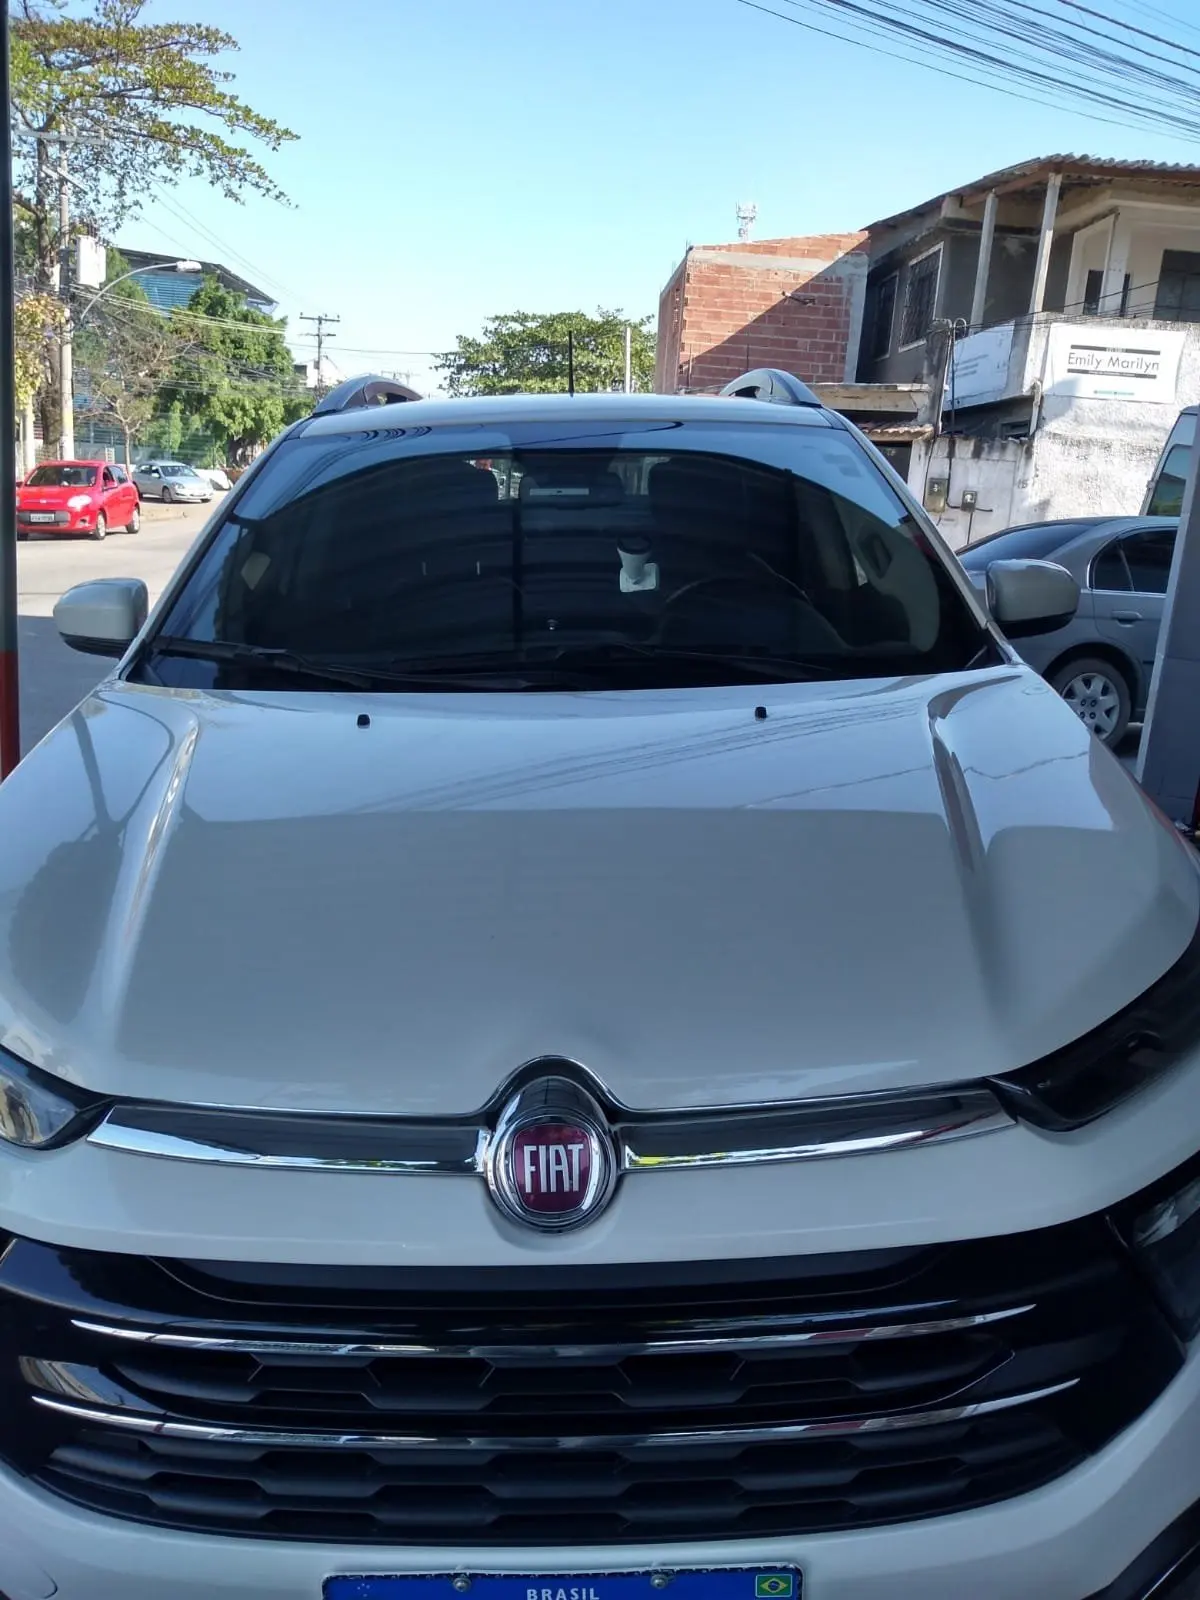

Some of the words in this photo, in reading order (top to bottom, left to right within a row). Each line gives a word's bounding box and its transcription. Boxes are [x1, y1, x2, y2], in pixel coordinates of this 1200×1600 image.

[1068, 352, 1102, 370] Emily
[1108, 356, 1160, 374] Marilyn
[523, 1143, 584, 1194] FIAT
[526, 1587, 600, 1600] BRASIL
